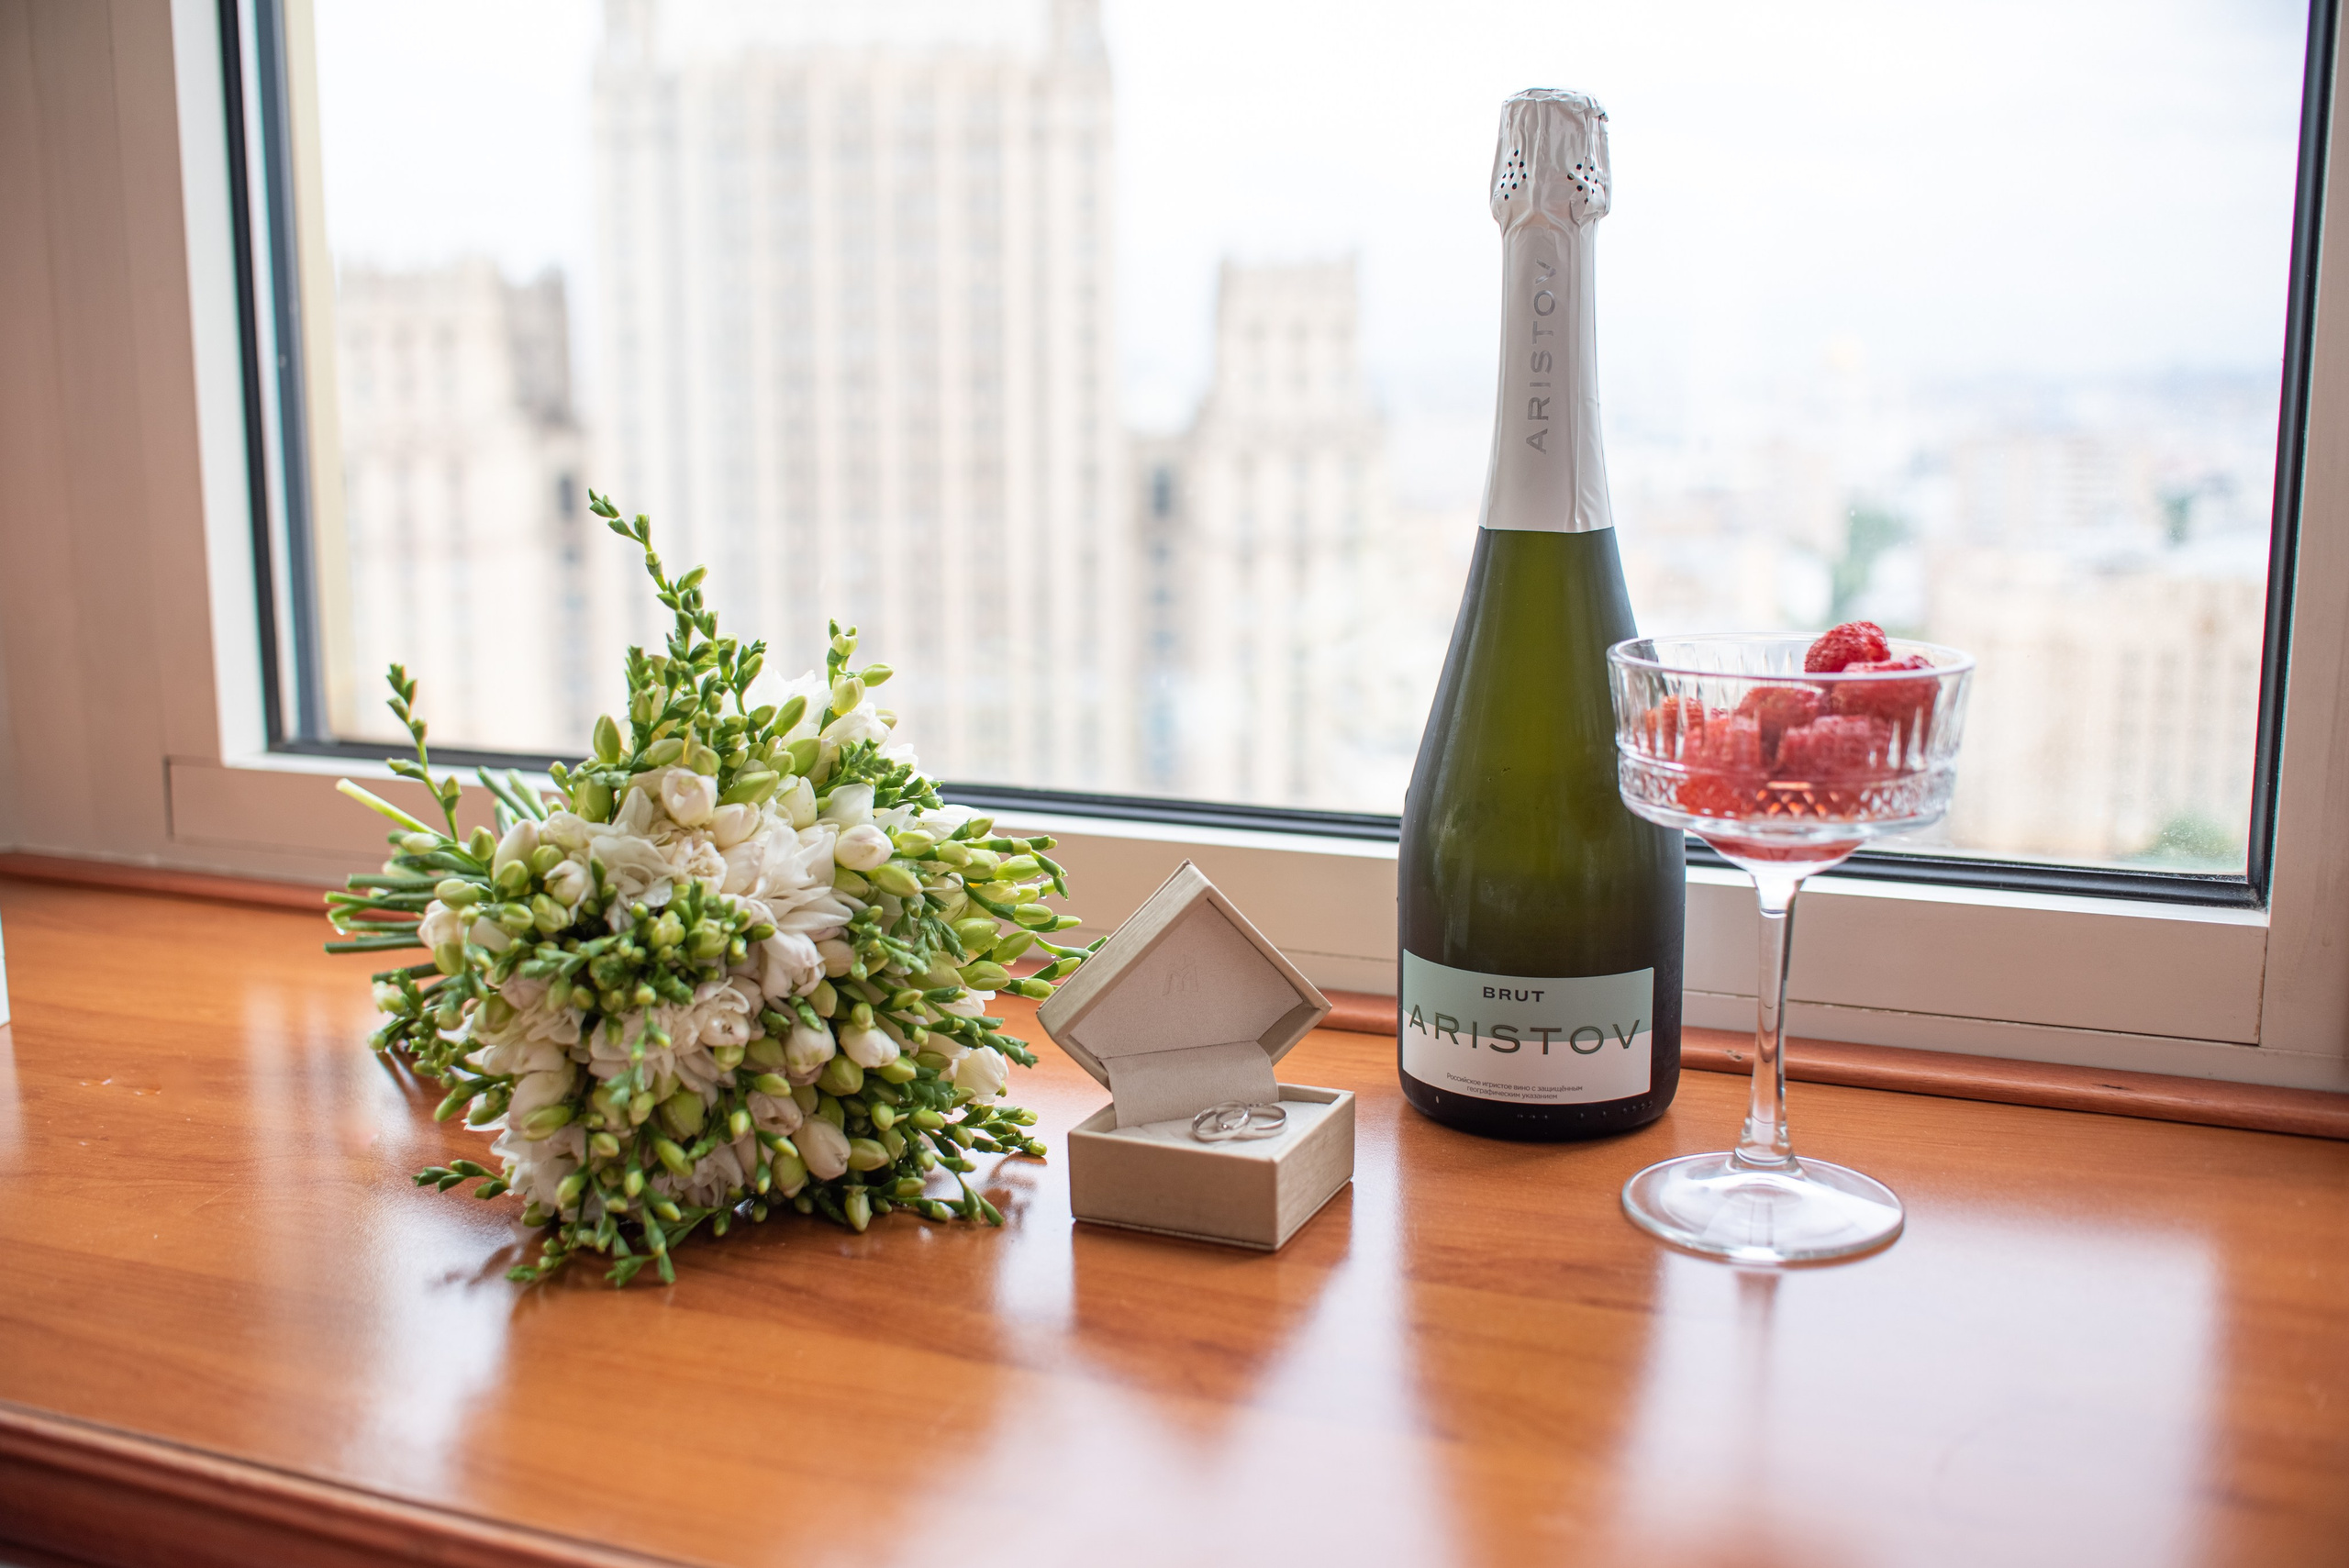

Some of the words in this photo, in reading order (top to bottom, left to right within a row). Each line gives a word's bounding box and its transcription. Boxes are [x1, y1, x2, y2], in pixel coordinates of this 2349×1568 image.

[1525, 258, 1558, 455] ARISTOV
[1482, 985, 1545, 1003] BRUT
[1408, 1004, 1641, 1055] ARISTOV
[1446, 1073, 1481, 1085] Российское
[1482, 1081, 1512, 1090] игристое
[1537, 1084, 1583, 1093] защищённым
[1466, 1085, 1520, 1098] географическим
